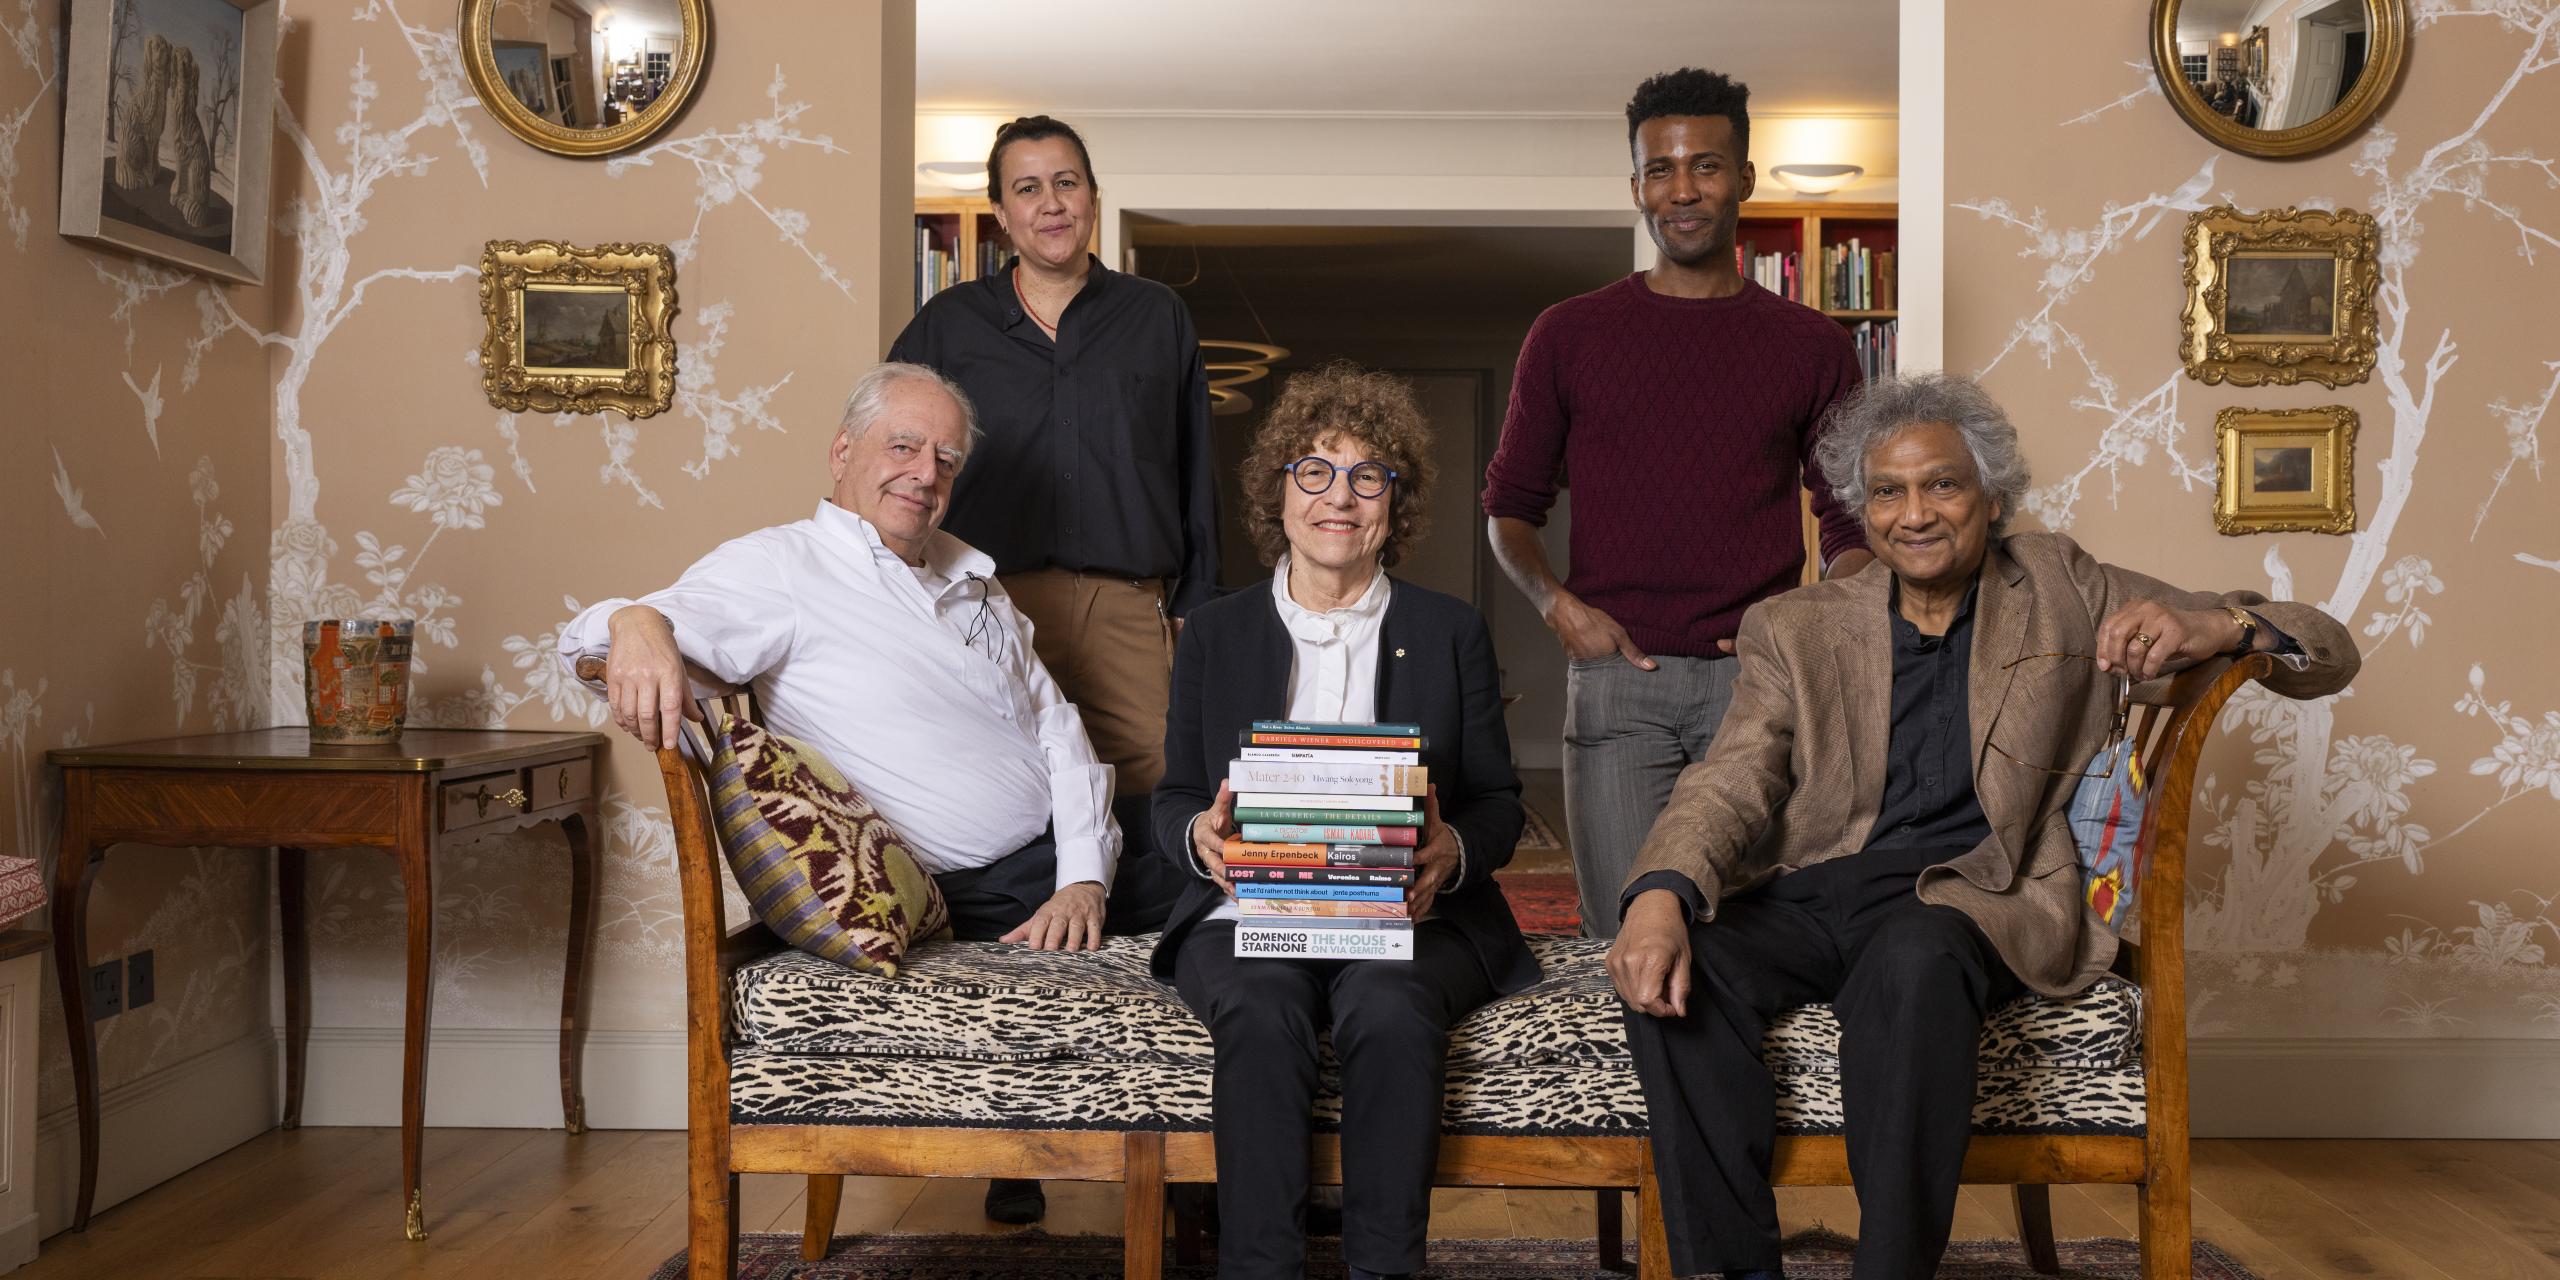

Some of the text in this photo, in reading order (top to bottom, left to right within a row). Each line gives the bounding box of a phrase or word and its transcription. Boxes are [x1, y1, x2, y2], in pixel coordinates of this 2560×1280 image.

[1260, 735, 1297, 743] GABRIELA
[1248, 770, 1280, 782] Mater
[1312, 774, 1339, 784] Hwang
[1273, 811, 1315, 819] GENBERG
[1323, 828, 1376, 841] ISMAIL KADARE
[1241, 849, 1319, 860] Jenny Erpenbeck
[1327, 851, 1356, 861] Kairos
[1229, 870, 1255, 878] LOST
[1298, 871, 1313, 879] ME
[1241, 932, 1308, 943] DOMENICO
[1311, 933, 1387, 946] THE HOUSE
[1241, 942, 1307, 953] STARNONE
[1311, 945, 1387, 955] ON VIA GEMITO
